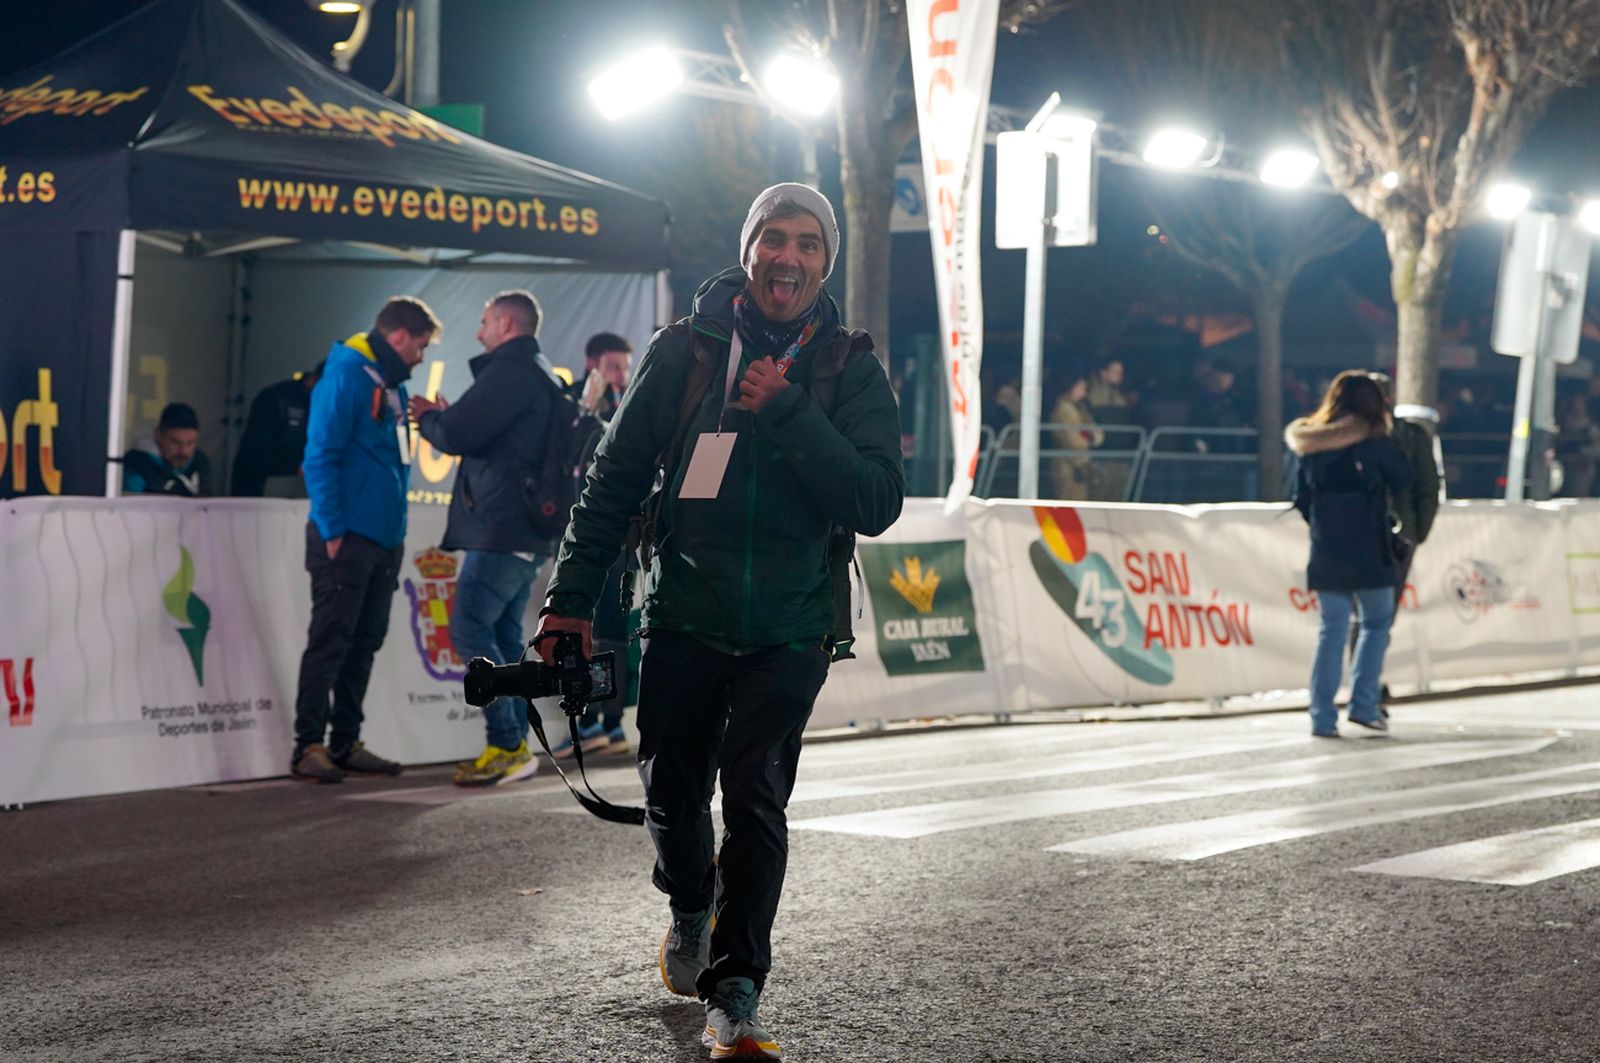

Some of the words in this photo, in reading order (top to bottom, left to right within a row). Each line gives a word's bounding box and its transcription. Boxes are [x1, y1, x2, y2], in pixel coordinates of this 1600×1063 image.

[238, 178, 600, 235] www.evedeport.es
[1124, 550, 1189, 596] SAN
[1075, 570, 1128, 648] 43
[1144, 588, 1254, 649] ANTÓN
[141, 705, 195, 720] Patronato
[197, 700, 251, 717] Municipal
[158, 721, 208, 737] Deportes
[211, 720, 225, 733] de
